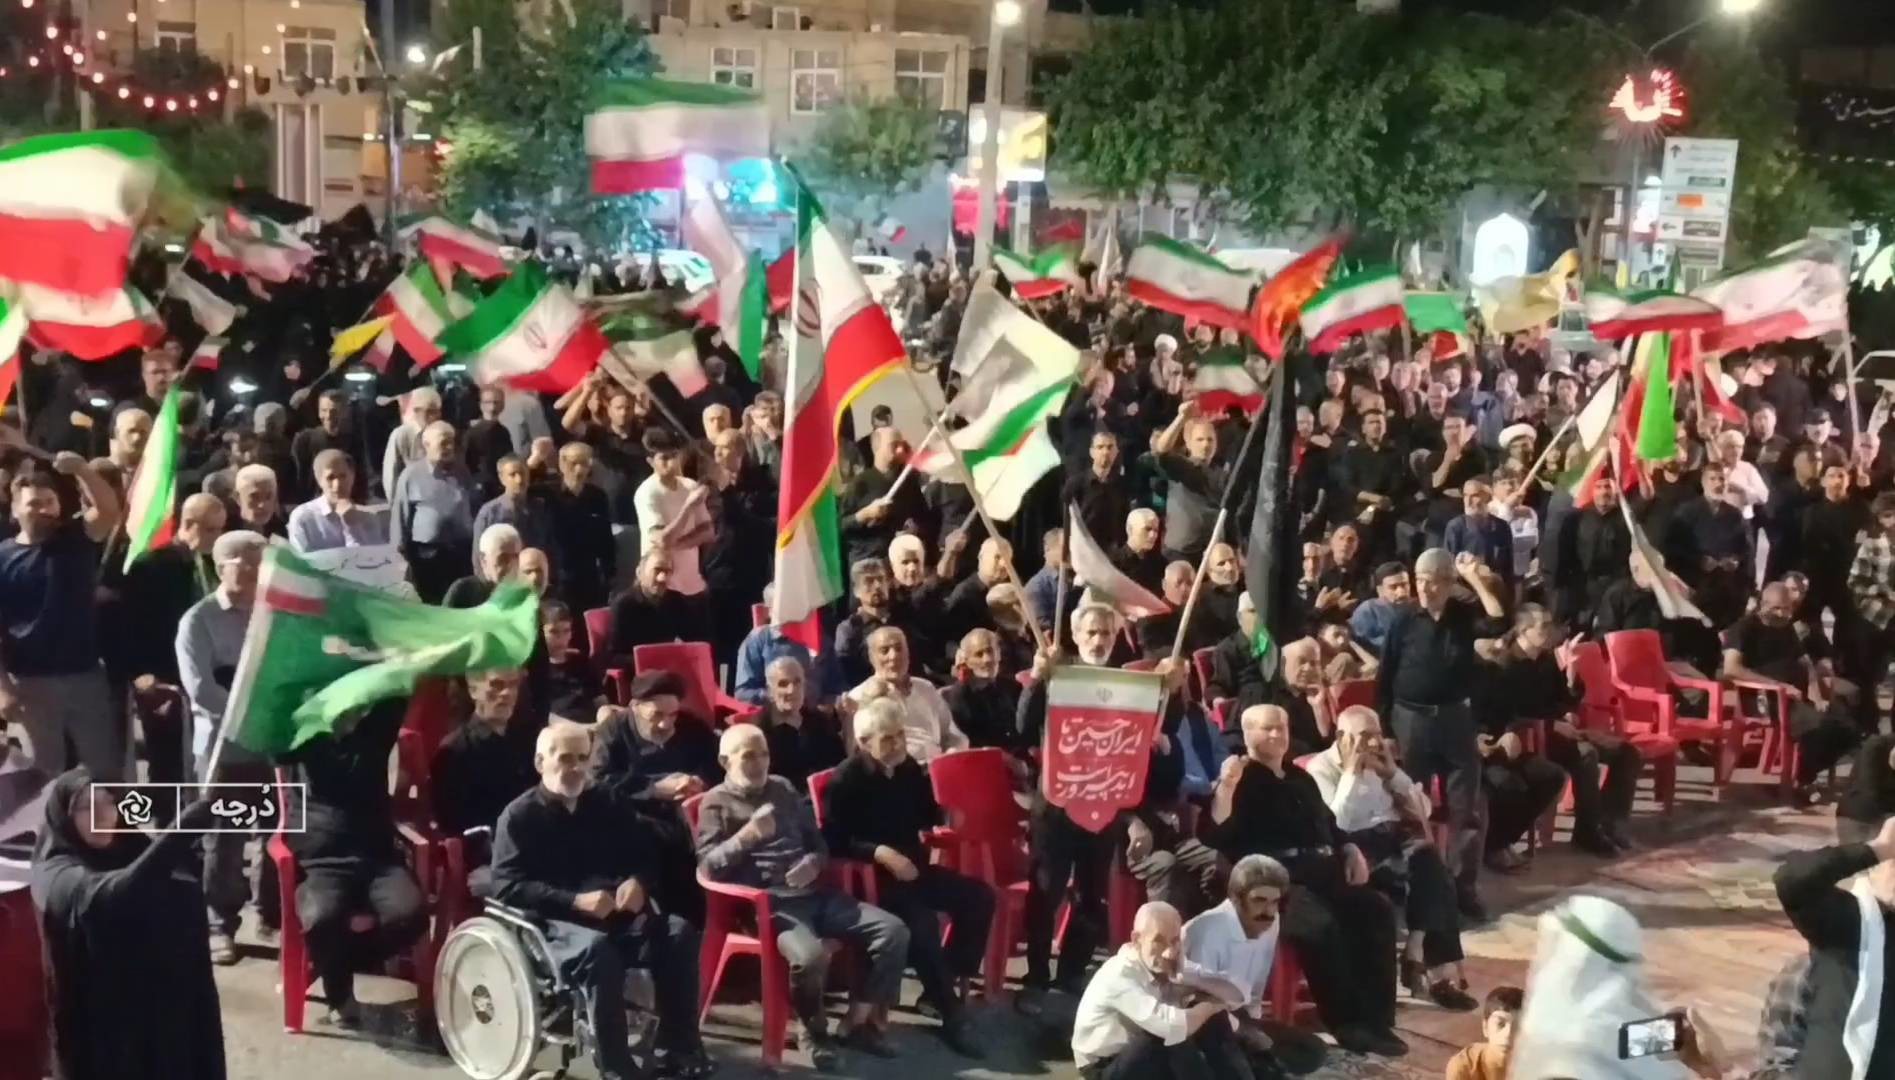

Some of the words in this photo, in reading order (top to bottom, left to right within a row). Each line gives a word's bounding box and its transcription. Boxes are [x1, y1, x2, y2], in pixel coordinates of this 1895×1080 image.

[1058, 718, 1132, 754] حسین
[1061, 717, 1084, 734] تا
[1095, 724, 1144, 756] ایران
[1055, 768, 1131, 801] پیروز
[1056, 763, 1113, 782] است
[1110, 771, 1137, 799] ابد
